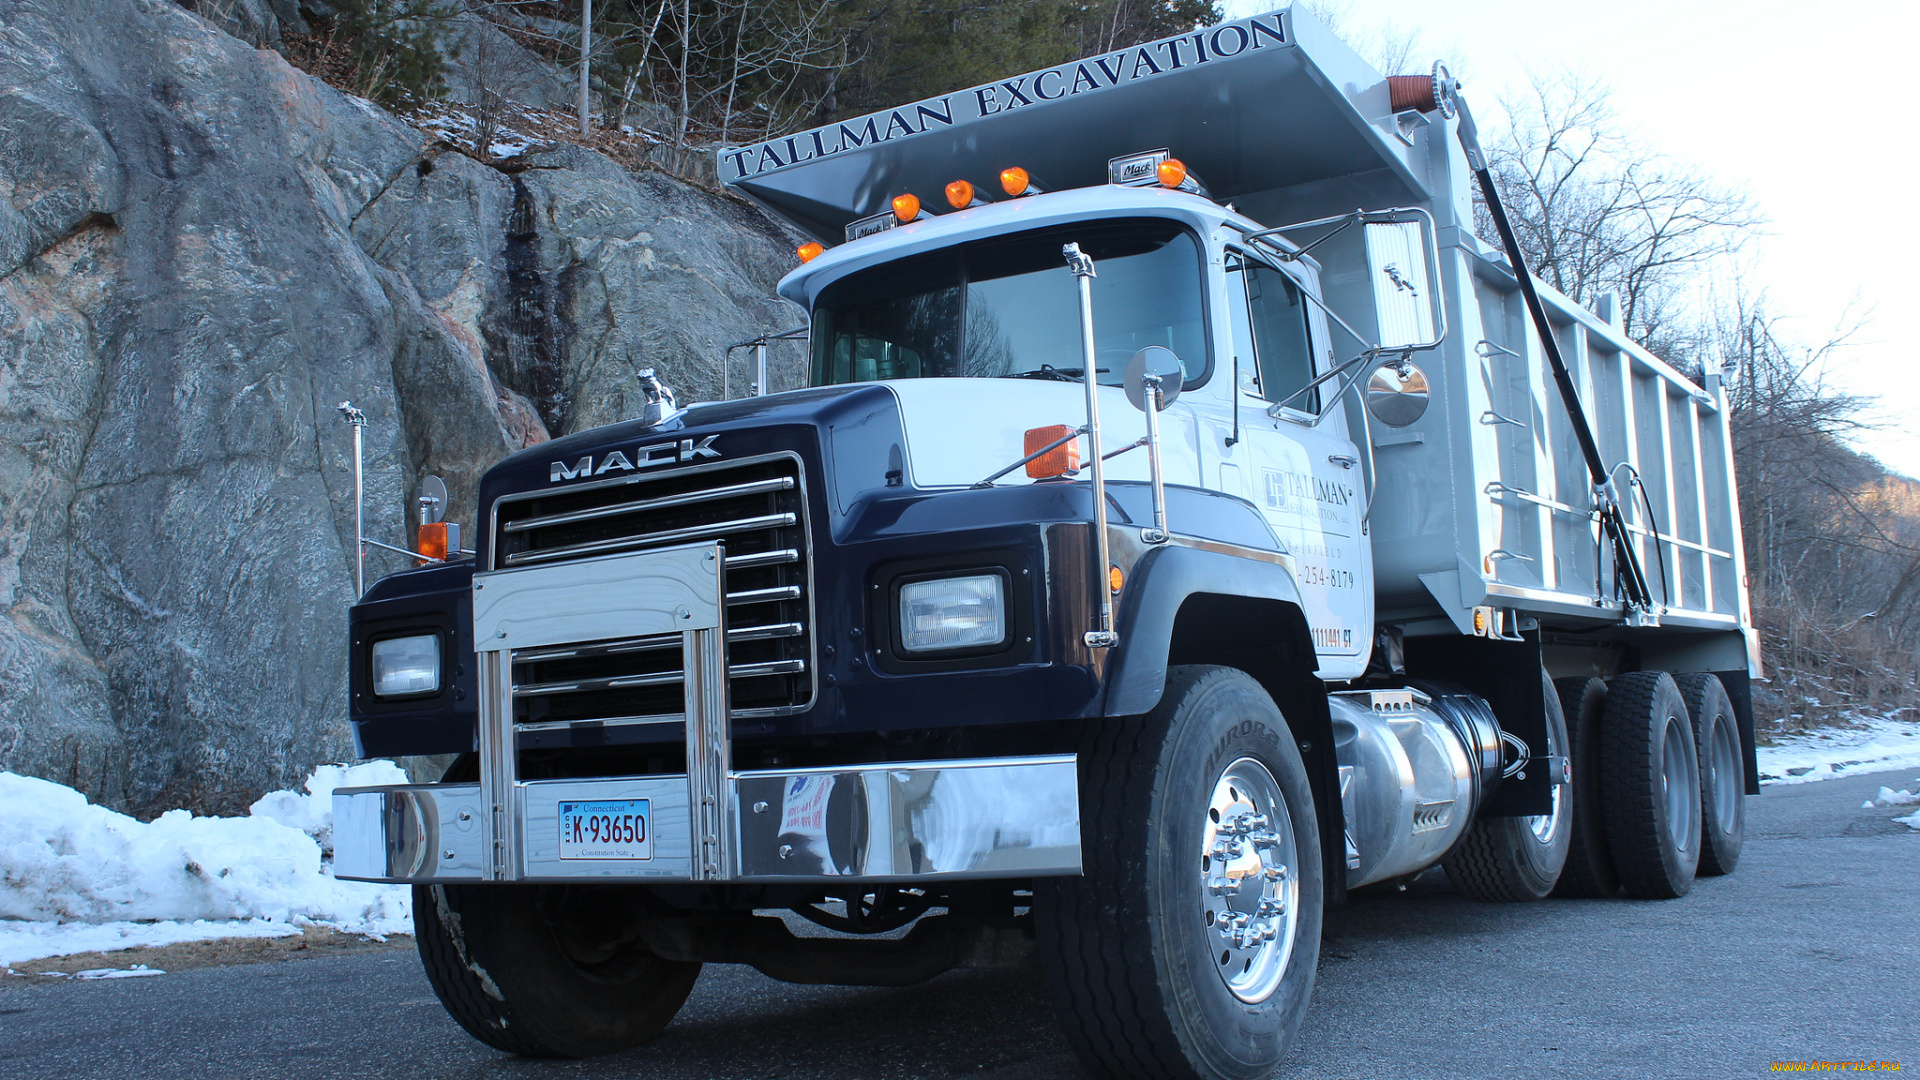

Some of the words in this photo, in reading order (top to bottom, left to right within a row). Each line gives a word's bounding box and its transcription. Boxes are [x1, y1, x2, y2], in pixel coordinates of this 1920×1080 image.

[724, 97, 954, 180] TALLMAN
[976, 12, 1288, 118] EXCAVATION
[1124, 162, 1151, 176] Mack
[859, 224, 882, 238] Mack
[550, 434, 722, 483] MACK
[1285, 471, 1348, 507] TALLMAN
[583, 804, 625, 813] Connecticut
